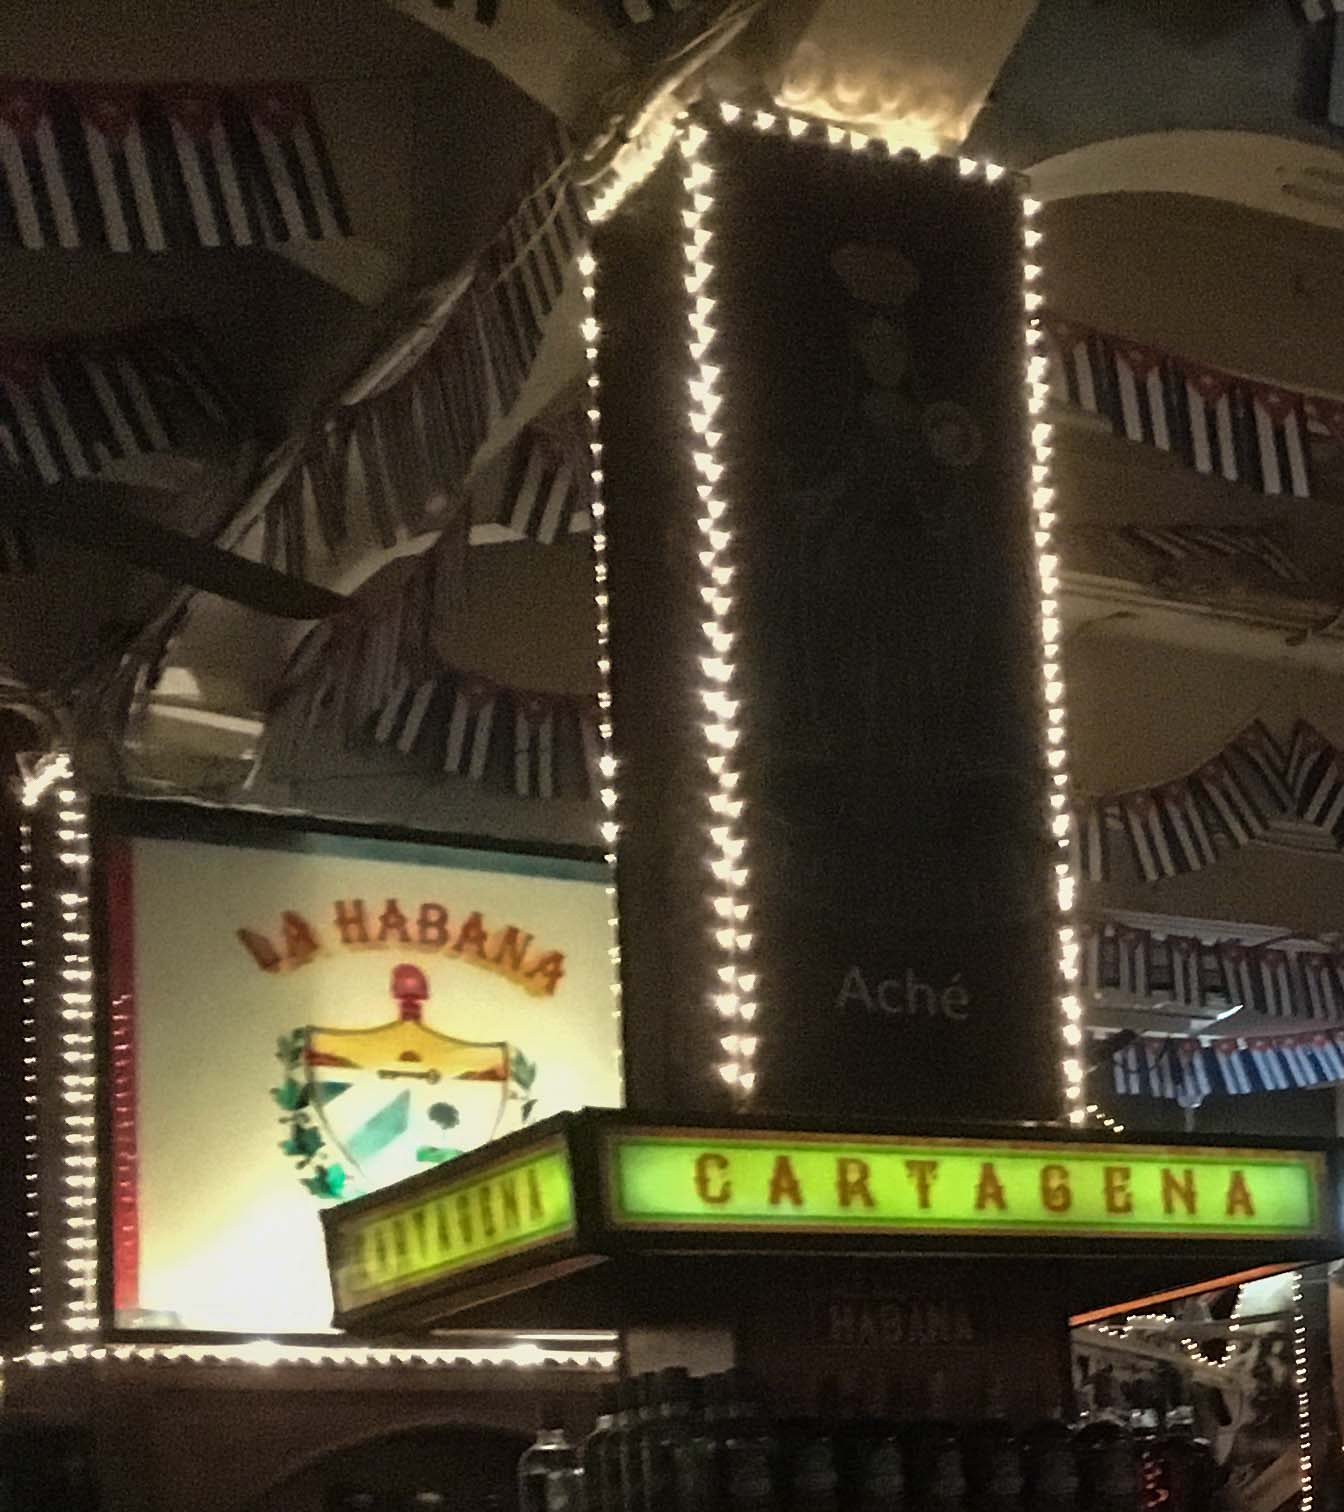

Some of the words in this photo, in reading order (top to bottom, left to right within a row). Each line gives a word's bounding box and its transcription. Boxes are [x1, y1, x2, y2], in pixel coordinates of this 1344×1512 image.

[237, 911, 320, 973] LA
[334, 899, 566, 997] HABANA
[835, 966, 969, 1021] Aché
[694, 1152, 1256, 1216] CARTAGENA
